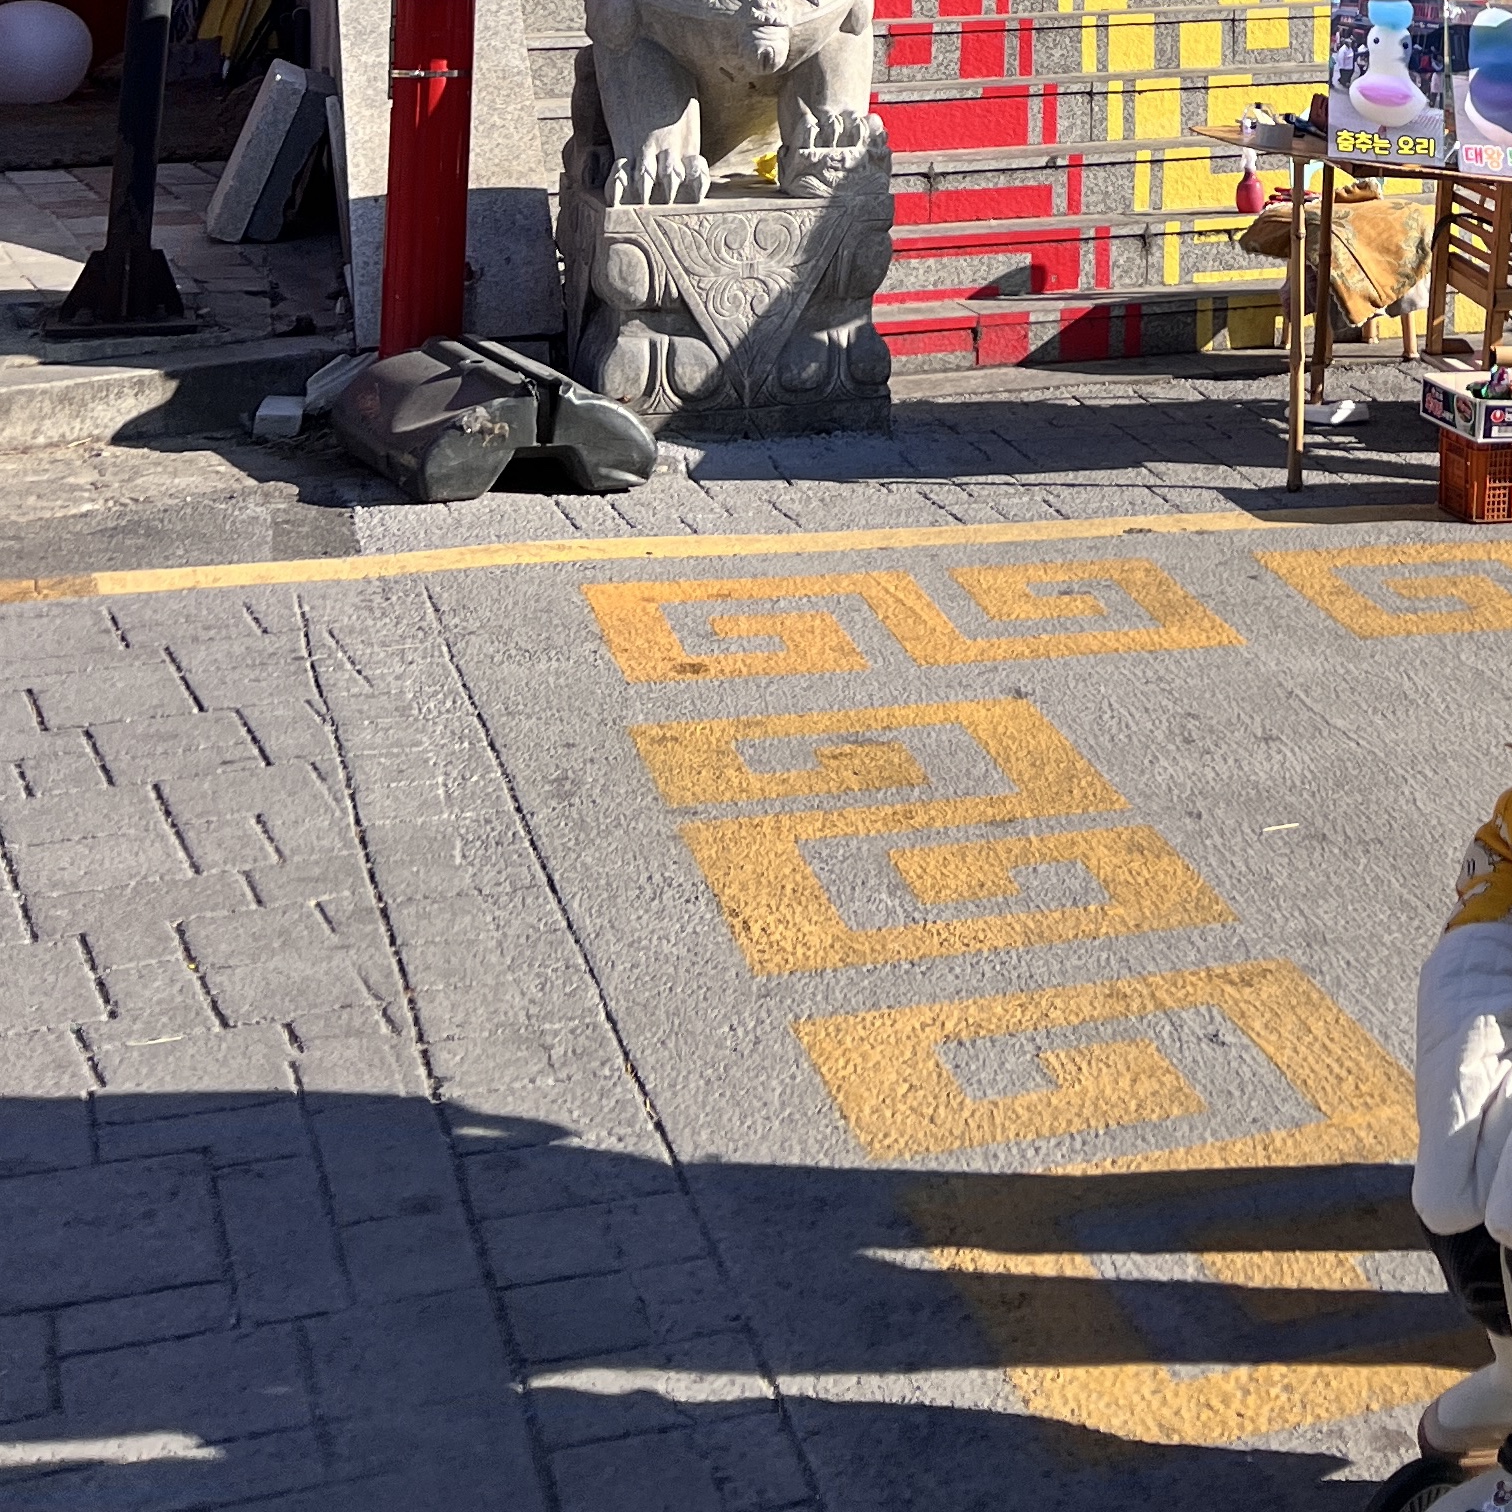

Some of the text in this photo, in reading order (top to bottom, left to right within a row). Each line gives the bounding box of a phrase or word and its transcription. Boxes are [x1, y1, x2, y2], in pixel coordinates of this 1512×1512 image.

[1335, 129, 1436, 158] 춤추는 오리
[1462, 143, 1504, 171] 대왕
